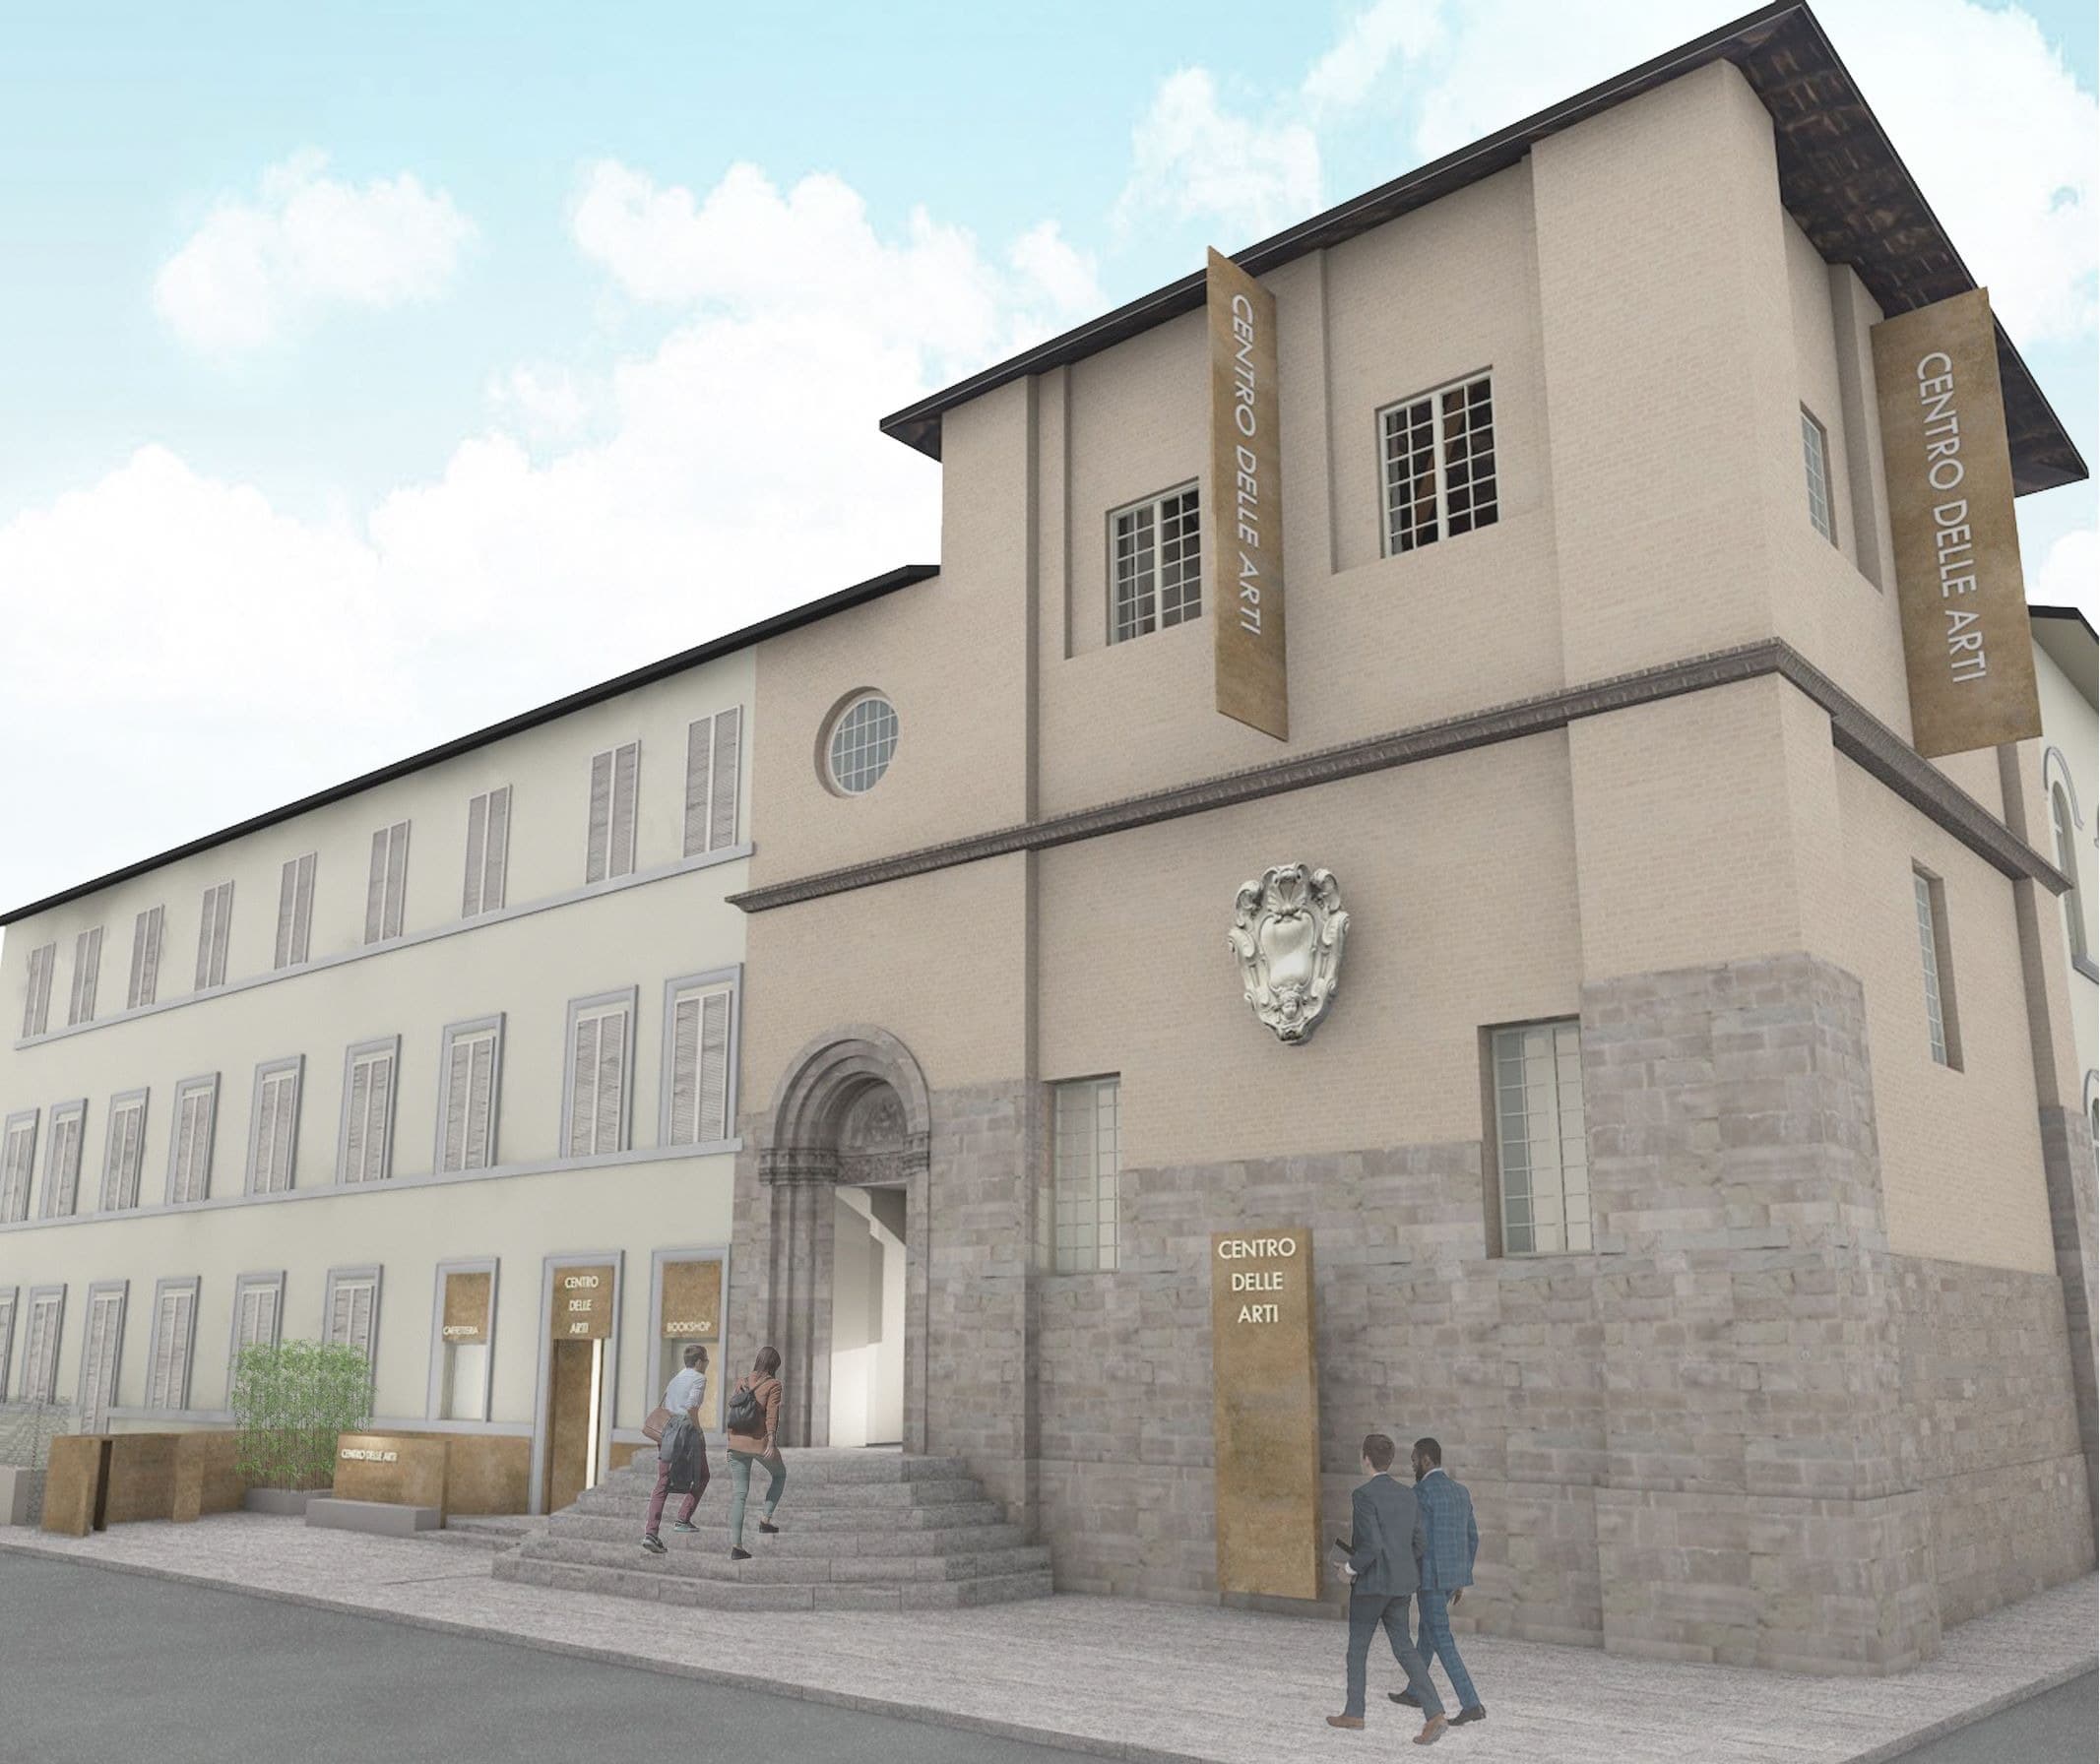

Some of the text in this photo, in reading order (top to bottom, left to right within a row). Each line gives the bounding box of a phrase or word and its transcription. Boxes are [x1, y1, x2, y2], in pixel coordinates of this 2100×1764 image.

[1233, 294, 1261, 635] CENTRO DELLE ARTI
[1917, 351, 1987, 682] CENTRO DELLE ARTI
[1218, 1237, 1296, 1259] CENTRO
[564, 1276, 600, 1289] CENTRO
[1232, 1271, 1284, 1292] DELLE
[569, 1299, 592, 1311] DELLE
[1238, 1304, 1279, 1323] ARTI
[569, 1322, 589, 1334] ARTI
[667, 1321, 711, 1333] BOOKSHOP
